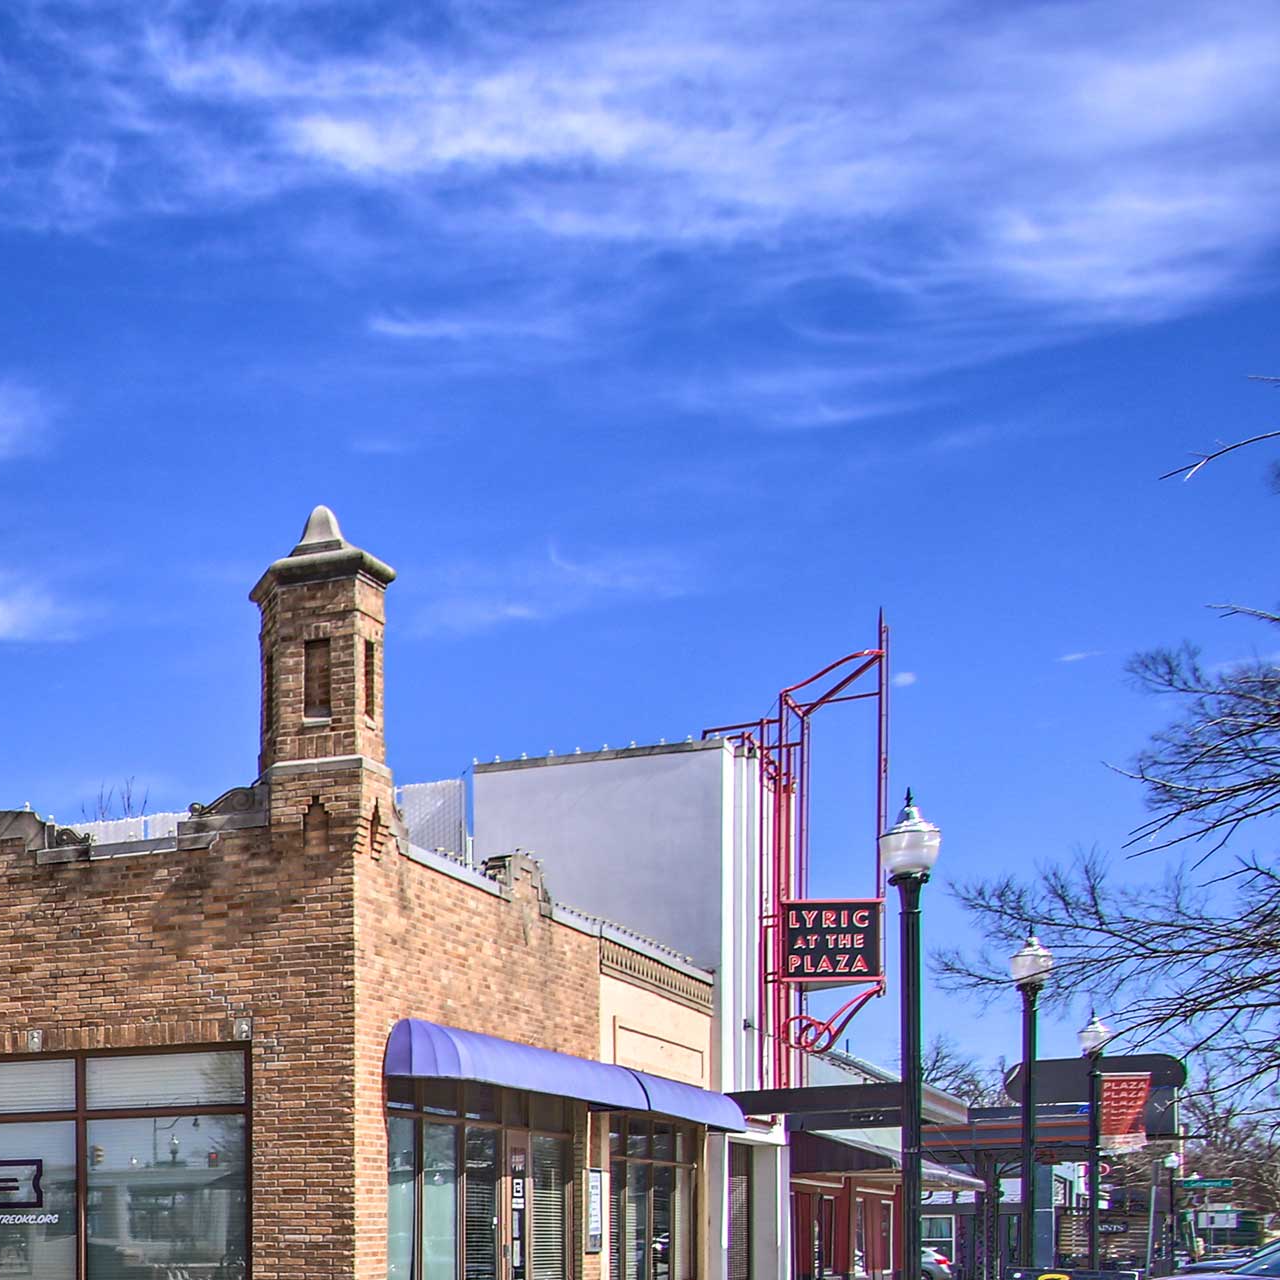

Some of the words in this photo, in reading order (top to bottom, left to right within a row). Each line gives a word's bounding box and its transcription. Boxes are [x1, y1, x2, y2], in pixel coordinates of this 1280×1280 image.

[789, 909, 869, 928] LYRIC
[793, 934, 818, 949] AT
[825, 933, 864, 949] THE
[788, 954, 869, 973] PLAZA
[1103, 1082, 1146, 1090] PLAZA
